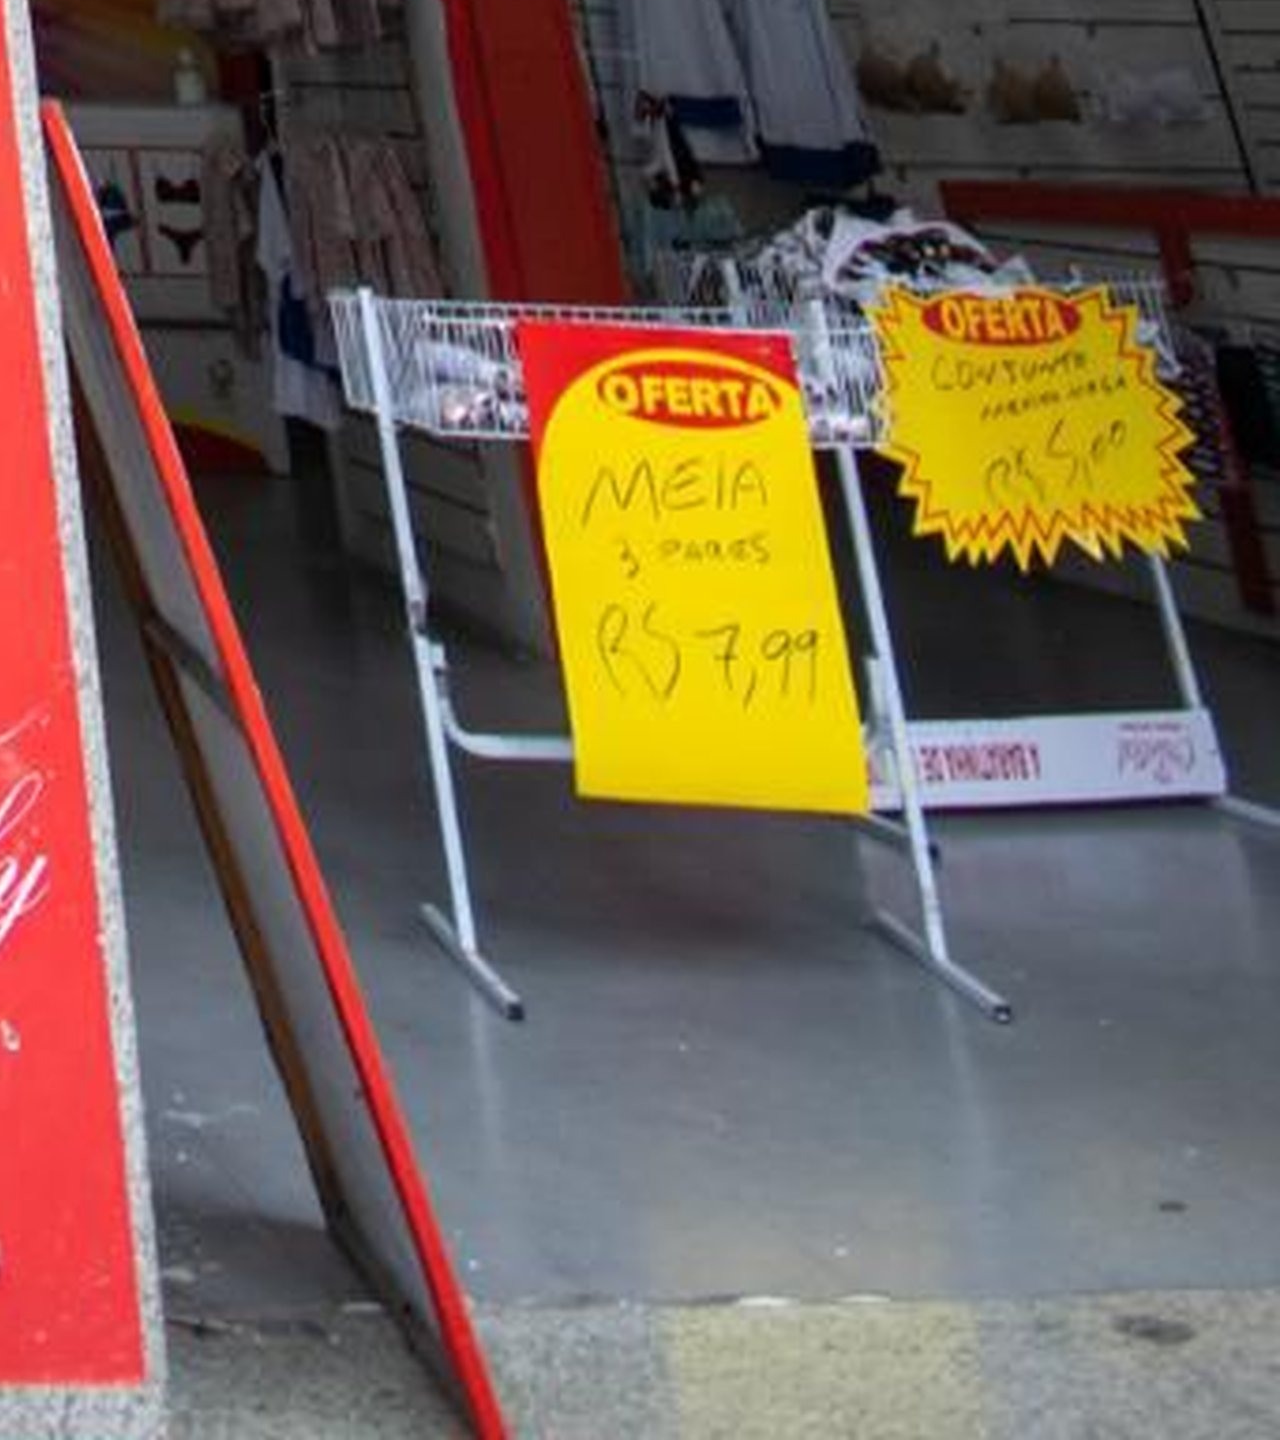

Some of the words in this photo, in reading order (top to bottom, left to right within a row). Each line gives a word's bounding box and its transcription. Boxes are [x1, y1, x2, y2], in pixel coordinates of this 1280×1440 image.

[939, 294, 1069, 342] OFERTA
[601, 373, 782, 420] OFERTA
[580, 458, 769, 529] MEIA
[695, 624, 820, 712] 7,99
